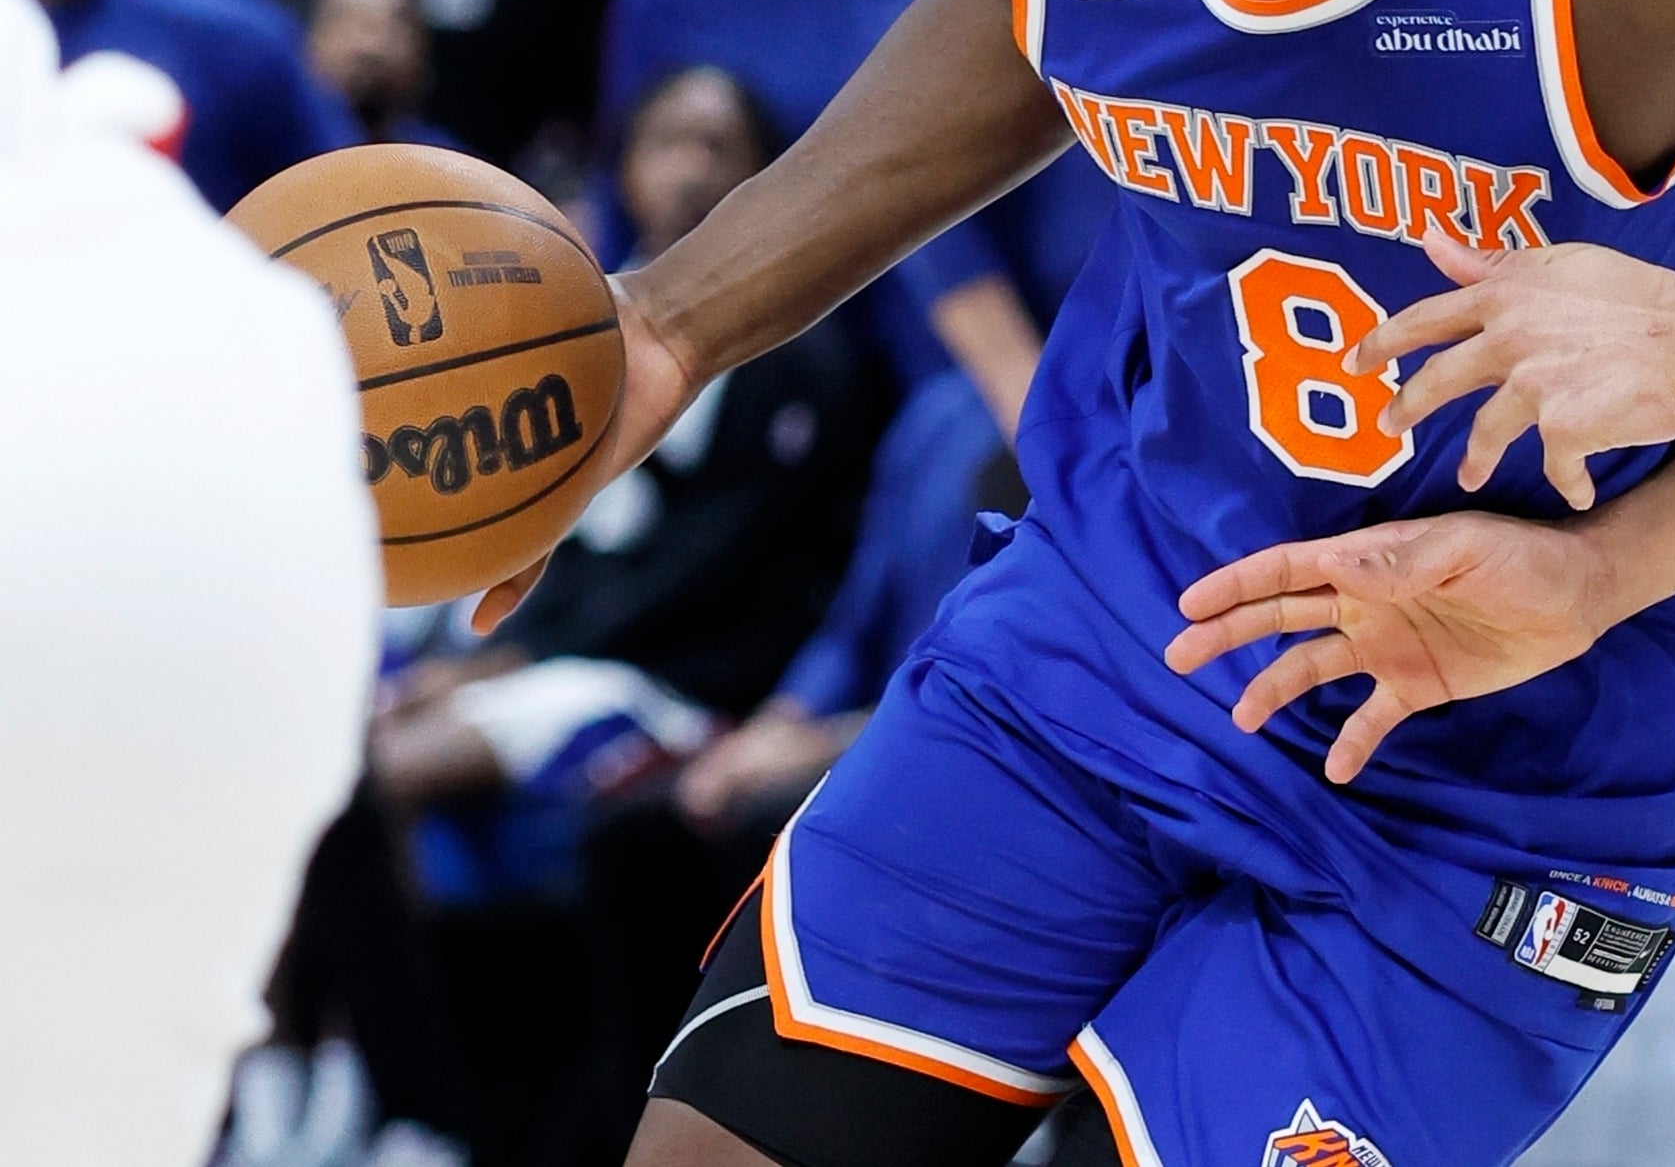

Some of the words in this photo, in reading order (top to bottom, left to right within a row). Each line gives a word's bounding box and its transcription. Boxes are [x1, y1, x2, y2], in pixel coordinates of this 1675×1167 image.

[1376, 15, 1453, 27] experience
[1375, 28, 1432, 51] abu
[1437, 26, 1521, 51] dhabi
[1049, 76, 1256, 217] NEW
[1257, 118, 1551, 249] YORK
[1228, 248, 1414, 487] 8
[362, 374, 584, 495] Wilso
[1582, 875, 1591, 885] A
[1572, 927, 1591, 946] 52
